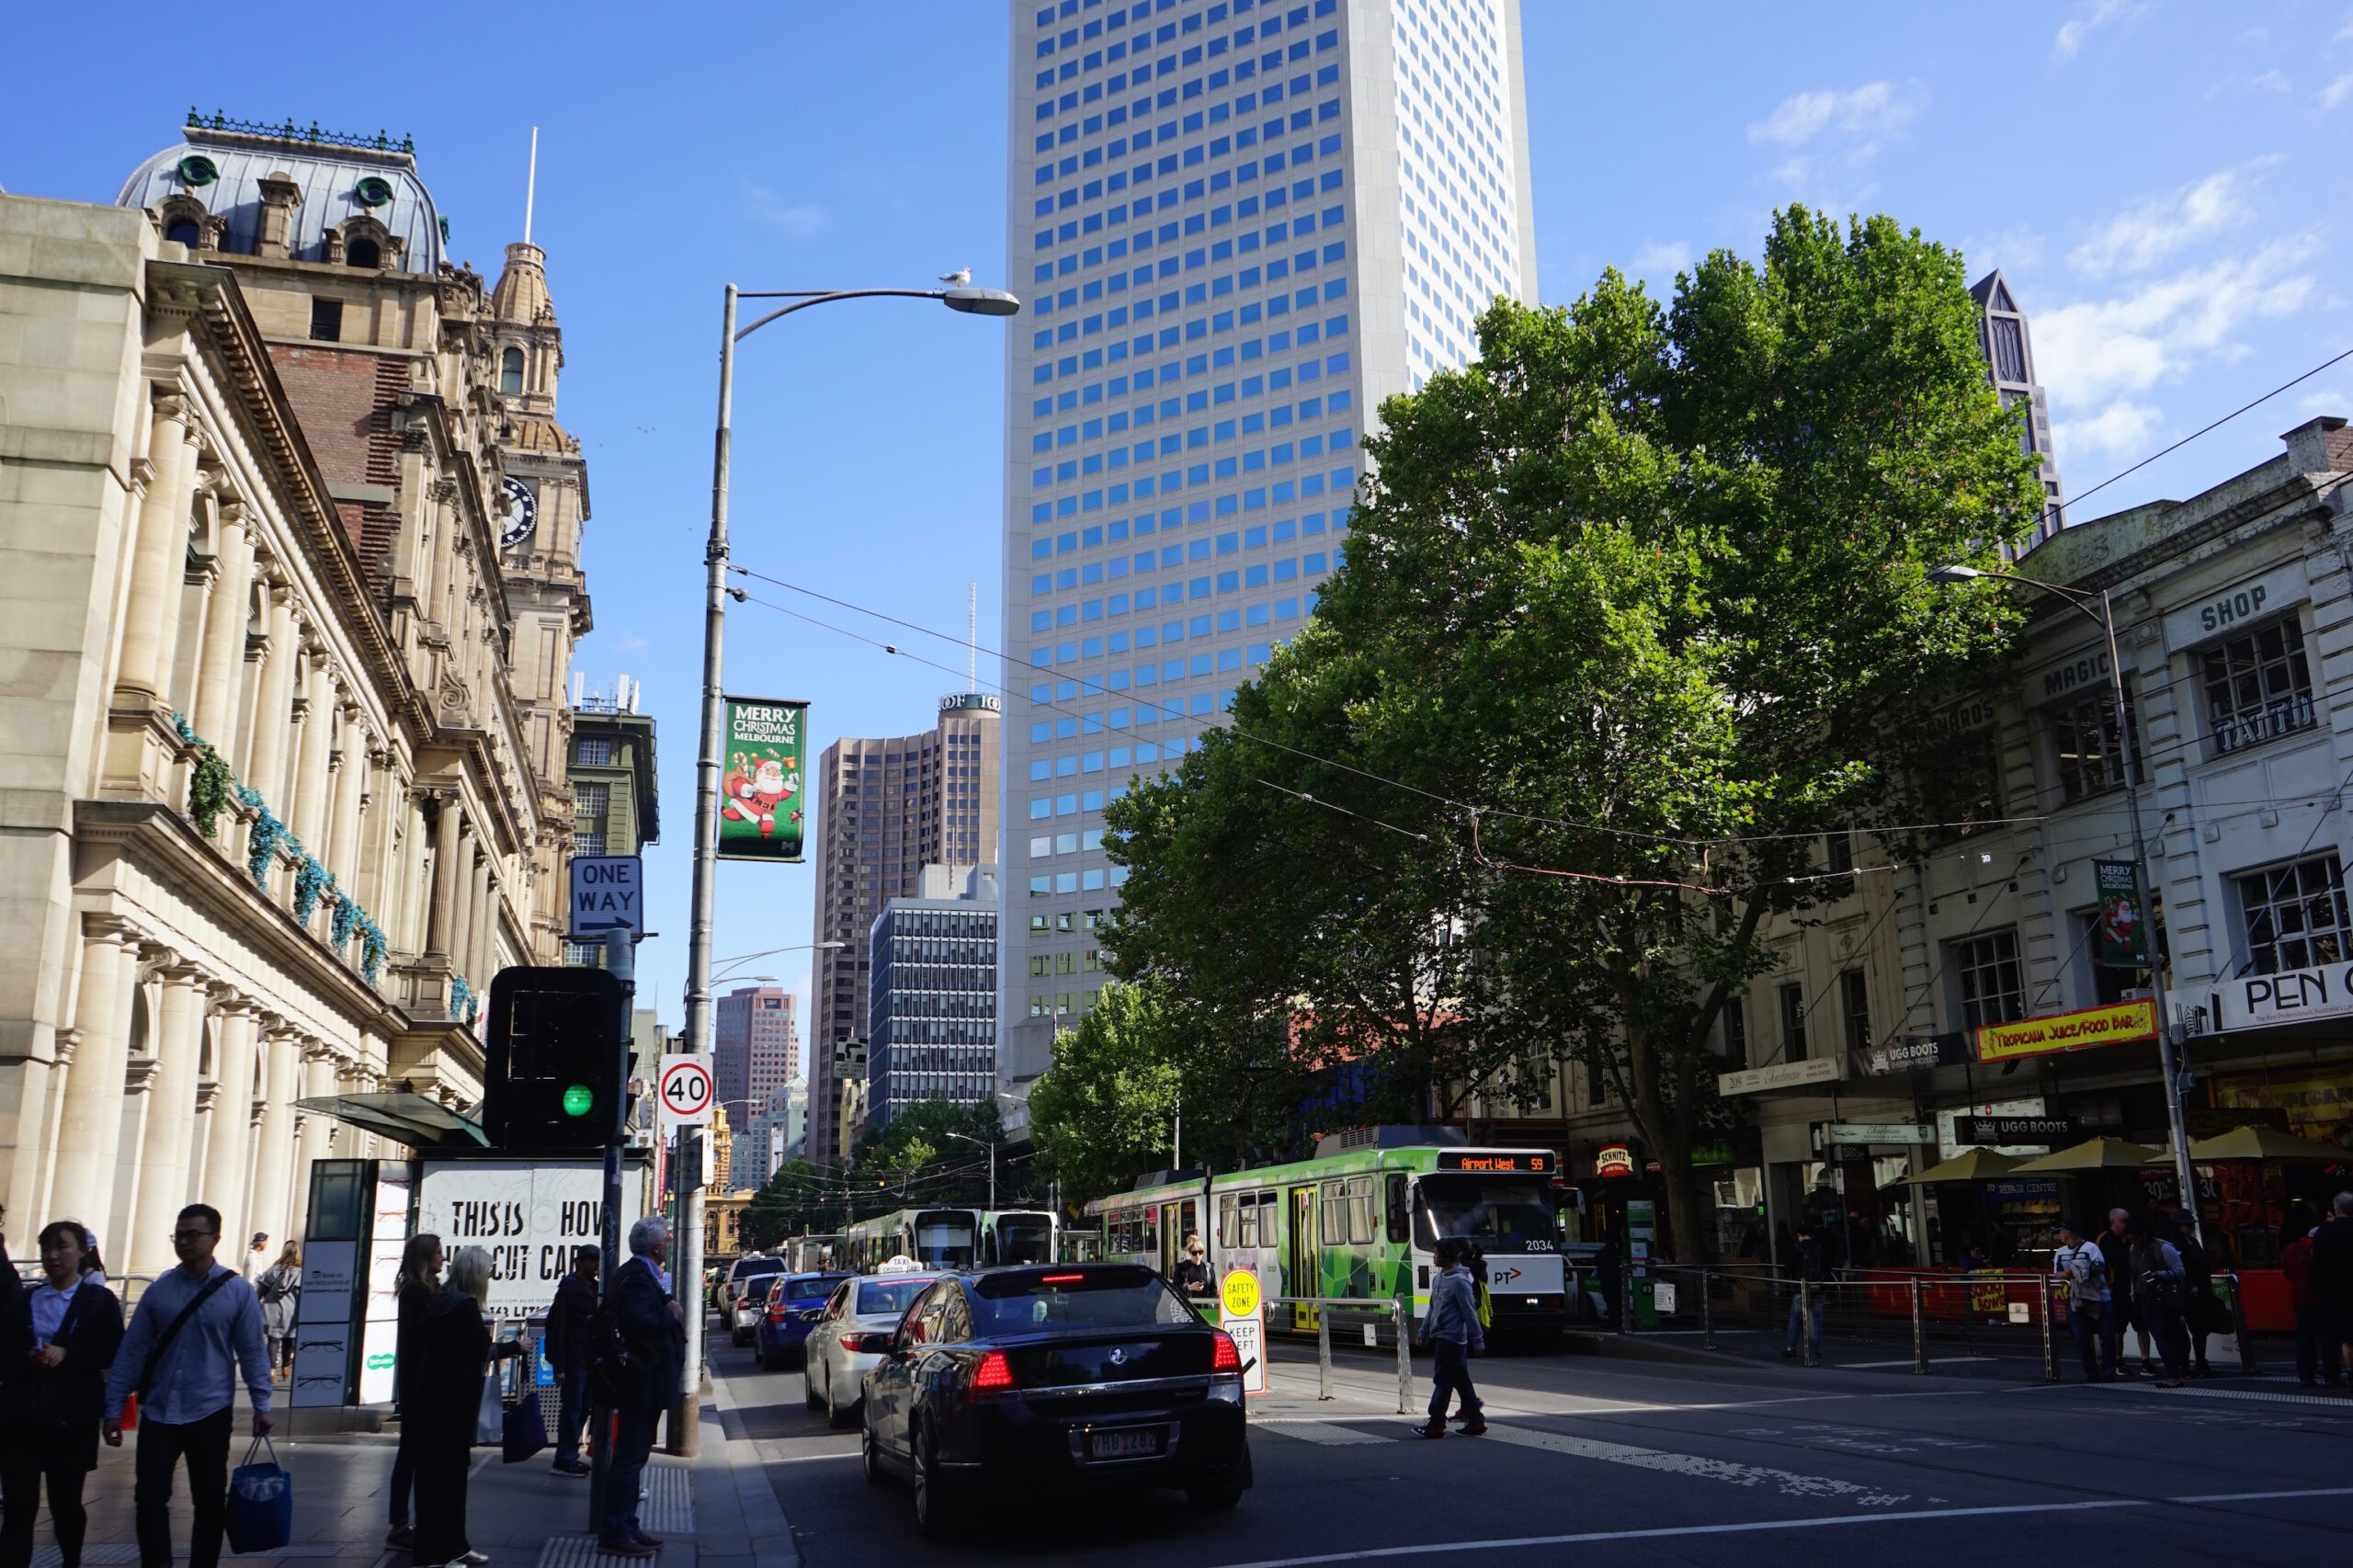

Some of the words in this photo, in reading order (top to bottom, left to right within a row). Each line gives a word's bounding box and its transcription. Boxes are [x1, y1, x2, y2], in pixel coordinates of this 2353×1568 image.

[2200, 585, 2267, 631] SHOP
[2045, 652, 2110, 696] MAGIC
[735, 706, 797, 723] MERRY
[733, 720, 796, 735] CHRISTMAS
[734, 733, 795, 744] MELBOURNE
[583, 864, 631, 884] ONE
[2099, 864, 2131, 875] MERRY
[578, 891, 635, 912] WAY
[2245, 970, 2328, 1015] PEN
[2314, 1005, 2343, 1015] Australia's
[1996, 1028, 2046, 1049] TROPICANA
[2111, 1014, 2134, 1030] BAR
[1889, 1048, 1909, 1061] UGG
[1910, 1041, 1938, 1058] BOOTS
[1915, 1056, 1939, 1066] PRODUCTS
[666, 1076, 705, 1101] 40
[1729, 1075, 1746, 1089] 209
[2000, 1120, 2029, 1133] UGG
[2029, 1119, 2068, 1133] BOOTS
[1461, 1158, 1493, 1170] Airport
[1495, 1158, 1515, 1170] West
[1530, 1158, 1543, 1170] 59
[1601, 1151, 1626, 1164] SCHNITZ
[1998, 1183, 2025, 1195] REPAIR
[2026, 1182, 2058, 1194] CENTRE
[1526, 1240, 1554, 1252] 2034
[492, 1244, 530, 1281] CUT
[1227, 1282, 1255, 1294] SAFETY
[1232, 1297, 1250, 1308] ZONE
[1229, 1326, 1255, 1338] KEEP
[1237, 1339, 1255, 1351] EFT
